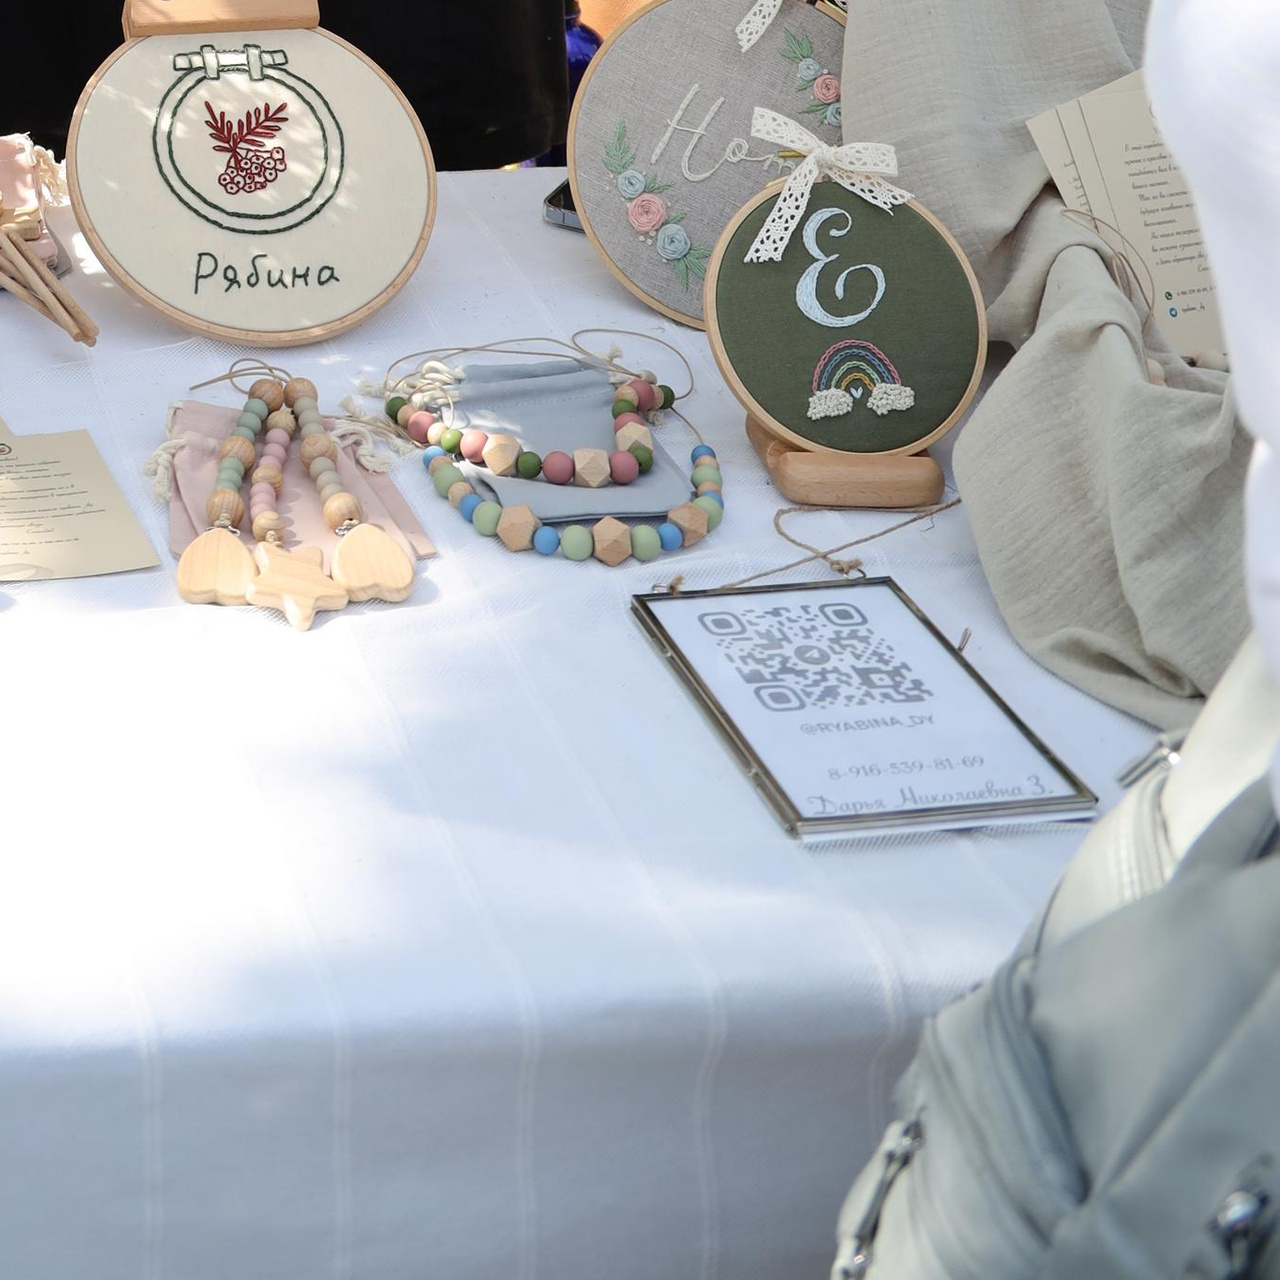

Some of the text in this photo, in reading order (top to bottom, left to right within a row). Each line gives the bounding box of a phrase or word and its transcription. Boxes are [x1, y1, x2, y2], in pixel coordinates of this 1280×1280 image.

[195, 252, 340, 294] Рябина
[800, 714, 934, 735] @RYABINA_DY
[826, 755, 985, 781] 8-916-539-81-69
